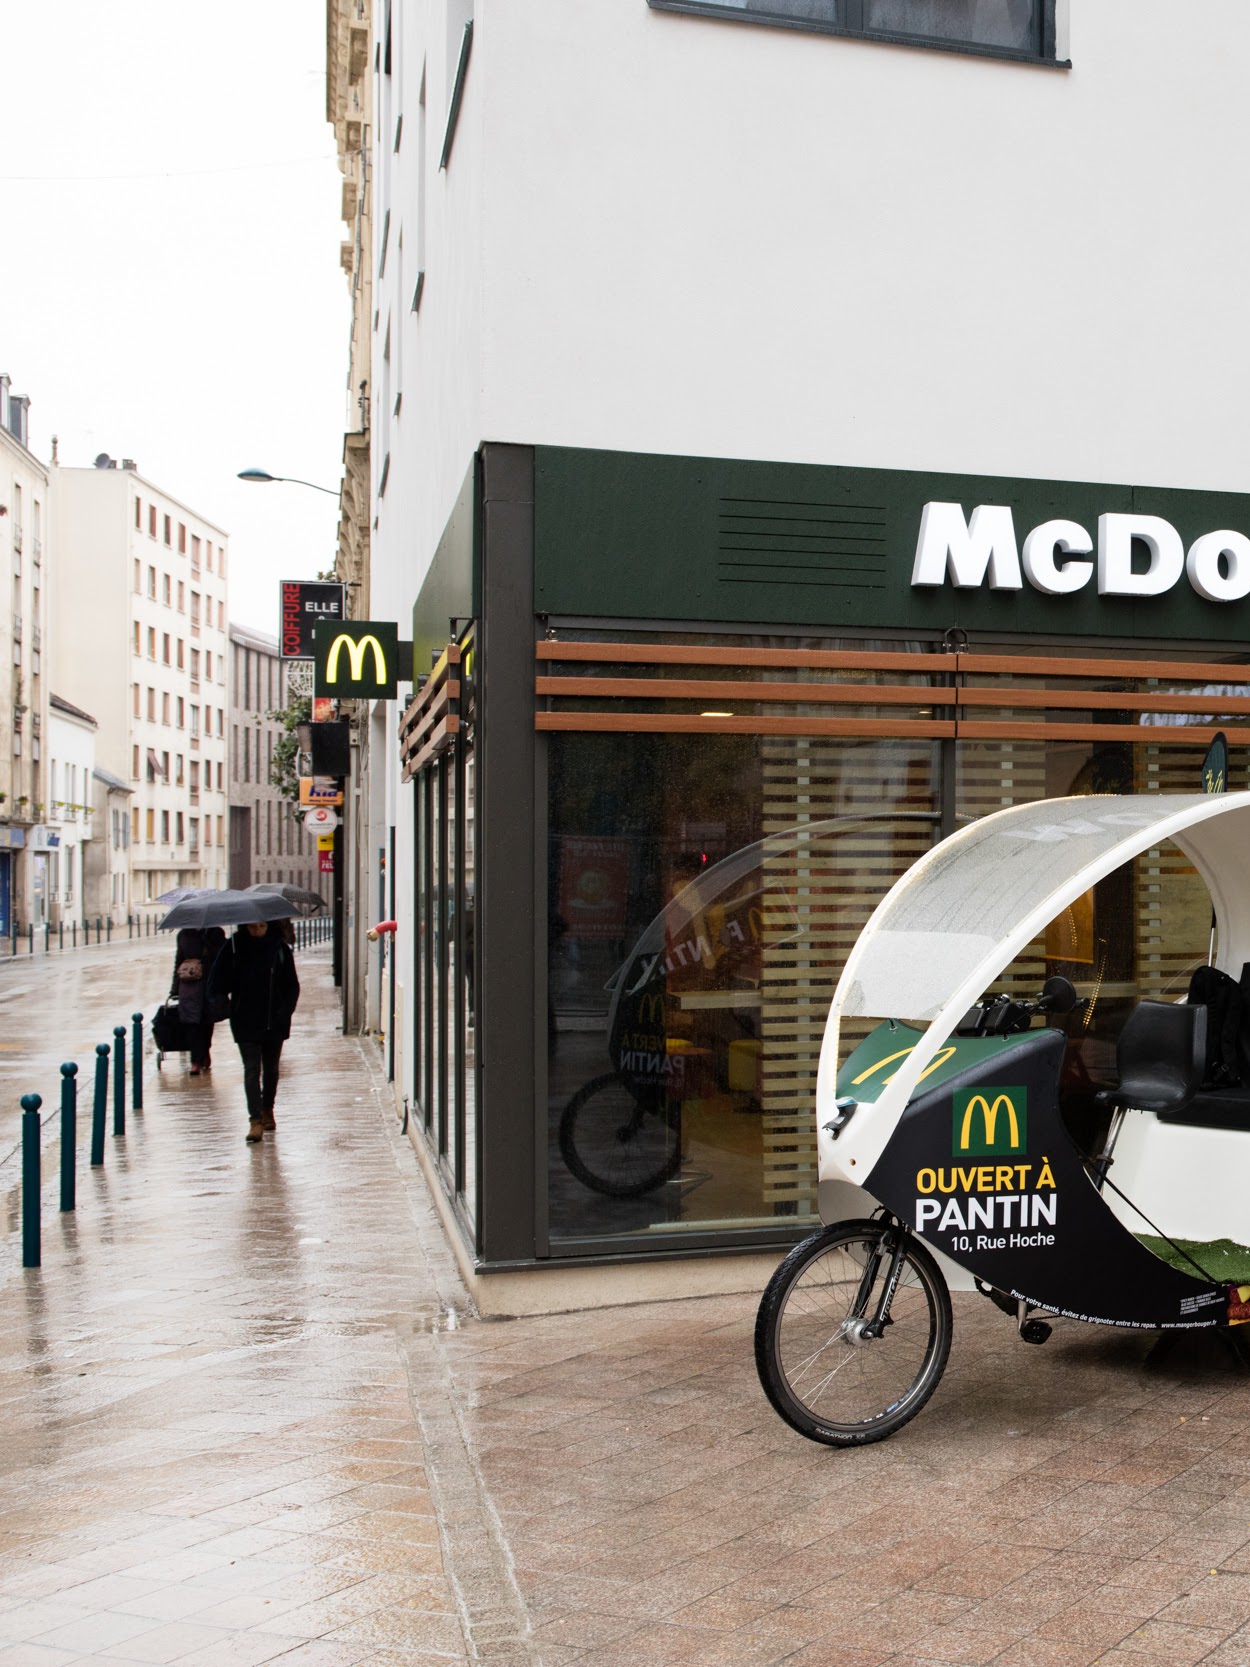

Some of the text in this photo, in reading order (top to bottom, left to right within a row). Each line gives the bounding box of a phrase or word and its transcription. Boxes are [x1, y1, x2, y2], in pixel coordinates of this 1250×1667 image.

[283, 583, 300, 656] COIFFURE
[305, 601, 339, 613] ELLE
[916, 1156, 1056, 1194] OUVERT À
[915, 1193, 1057, 1232] PANTIN
[951, 1232, 1055, 1253] 10, Rue Hoche
[1010, 1289, 1026, 1300] Pour
[1025, 1296, 1042, 1308] votre
[1042, 1304, 1060, 1314] santé,
[1061, 1308, 1079, 1319] évitez
[1088, 1315, 1115, 1325] grignoter
[1131, 1320, 1140, 1328] les
[1161, 1319, 1218, 1329] www.mangerbouger.fr
